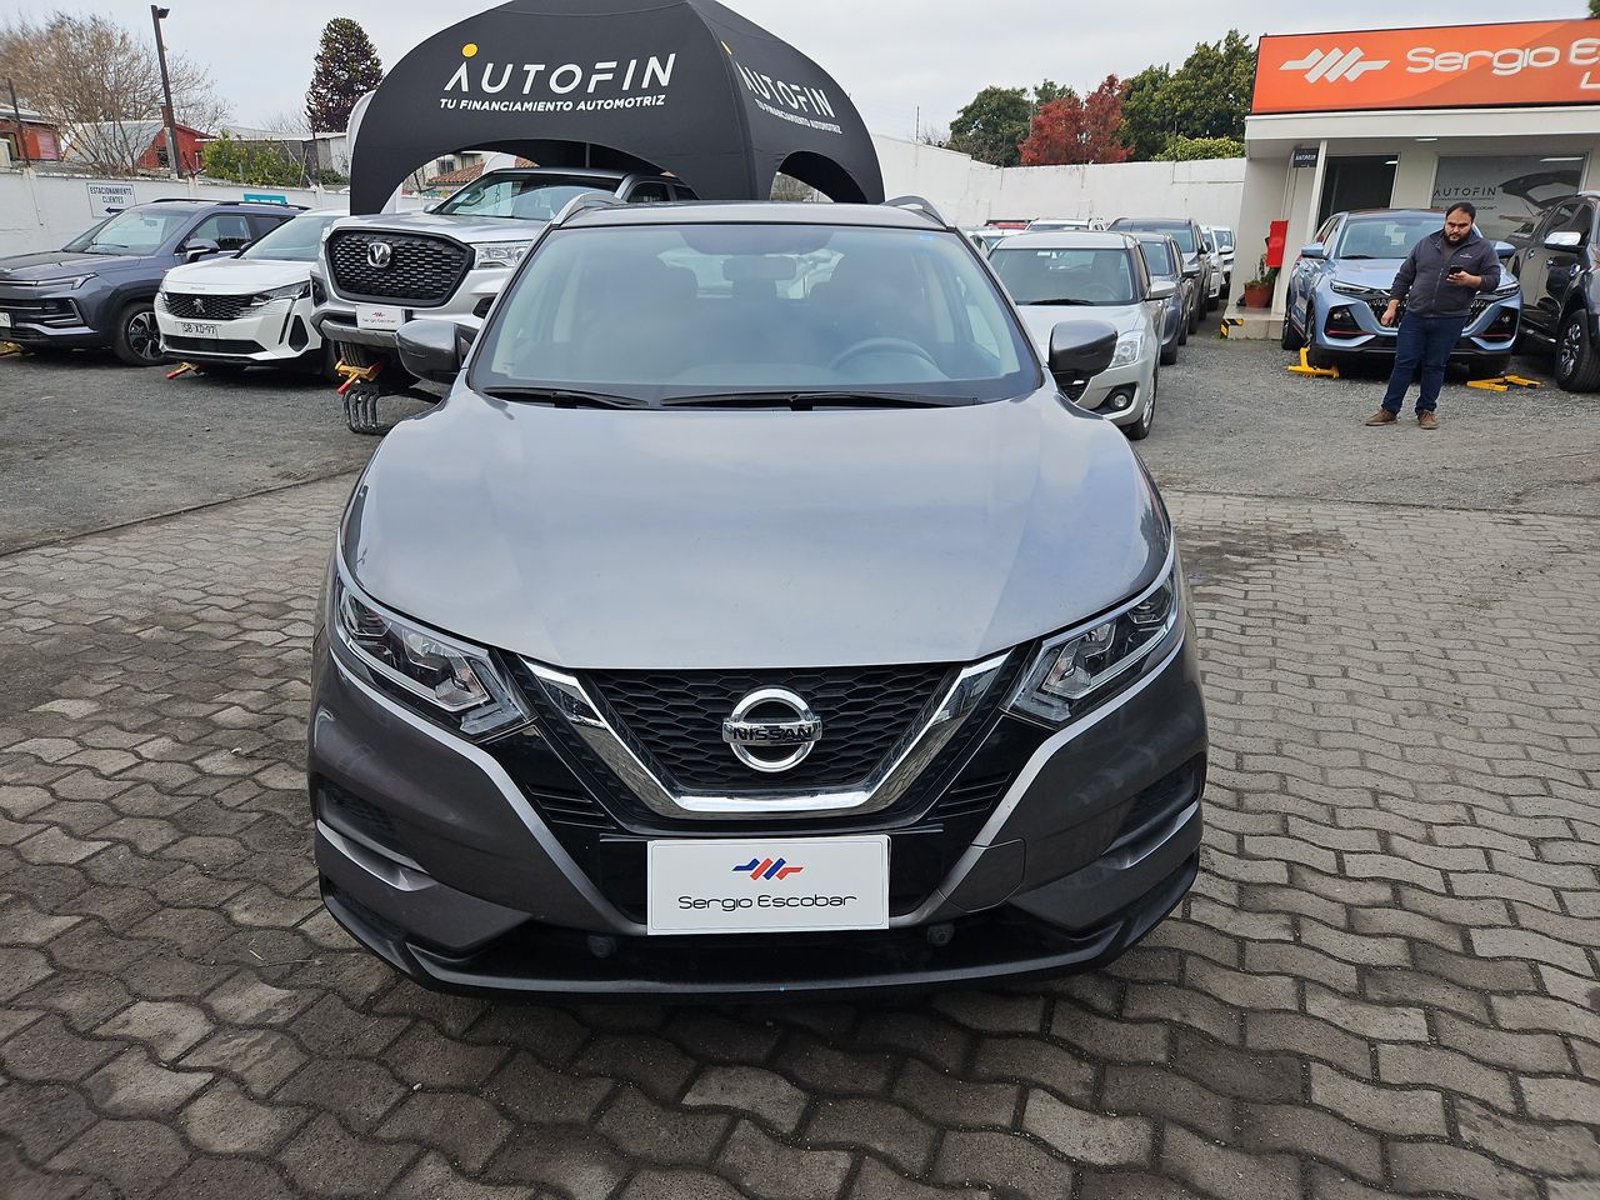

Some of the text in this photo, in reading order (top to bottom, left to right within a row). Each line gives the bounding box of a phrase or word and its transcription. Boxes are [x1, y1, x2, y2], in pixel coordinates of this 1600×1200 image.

[1405, 37, 1600, 76] Sergio E
[444, 53, 676, 94] AUTOFIN
[735, 61, 836, 118] AUTOFIN
[440, 95, 666, 112] TU FINANCIAMIENTO AUTOMOTRIZ
[89, 186, 132, 196] ESTACIONAMIENTO
[102, 195, 125, 204] CLIENTES
[1433, 186, 1497, 197] AUTOFIN
[733, 725, 812, 741] NISSAN
[678, 894, 857, 912] Sergio Escobar
